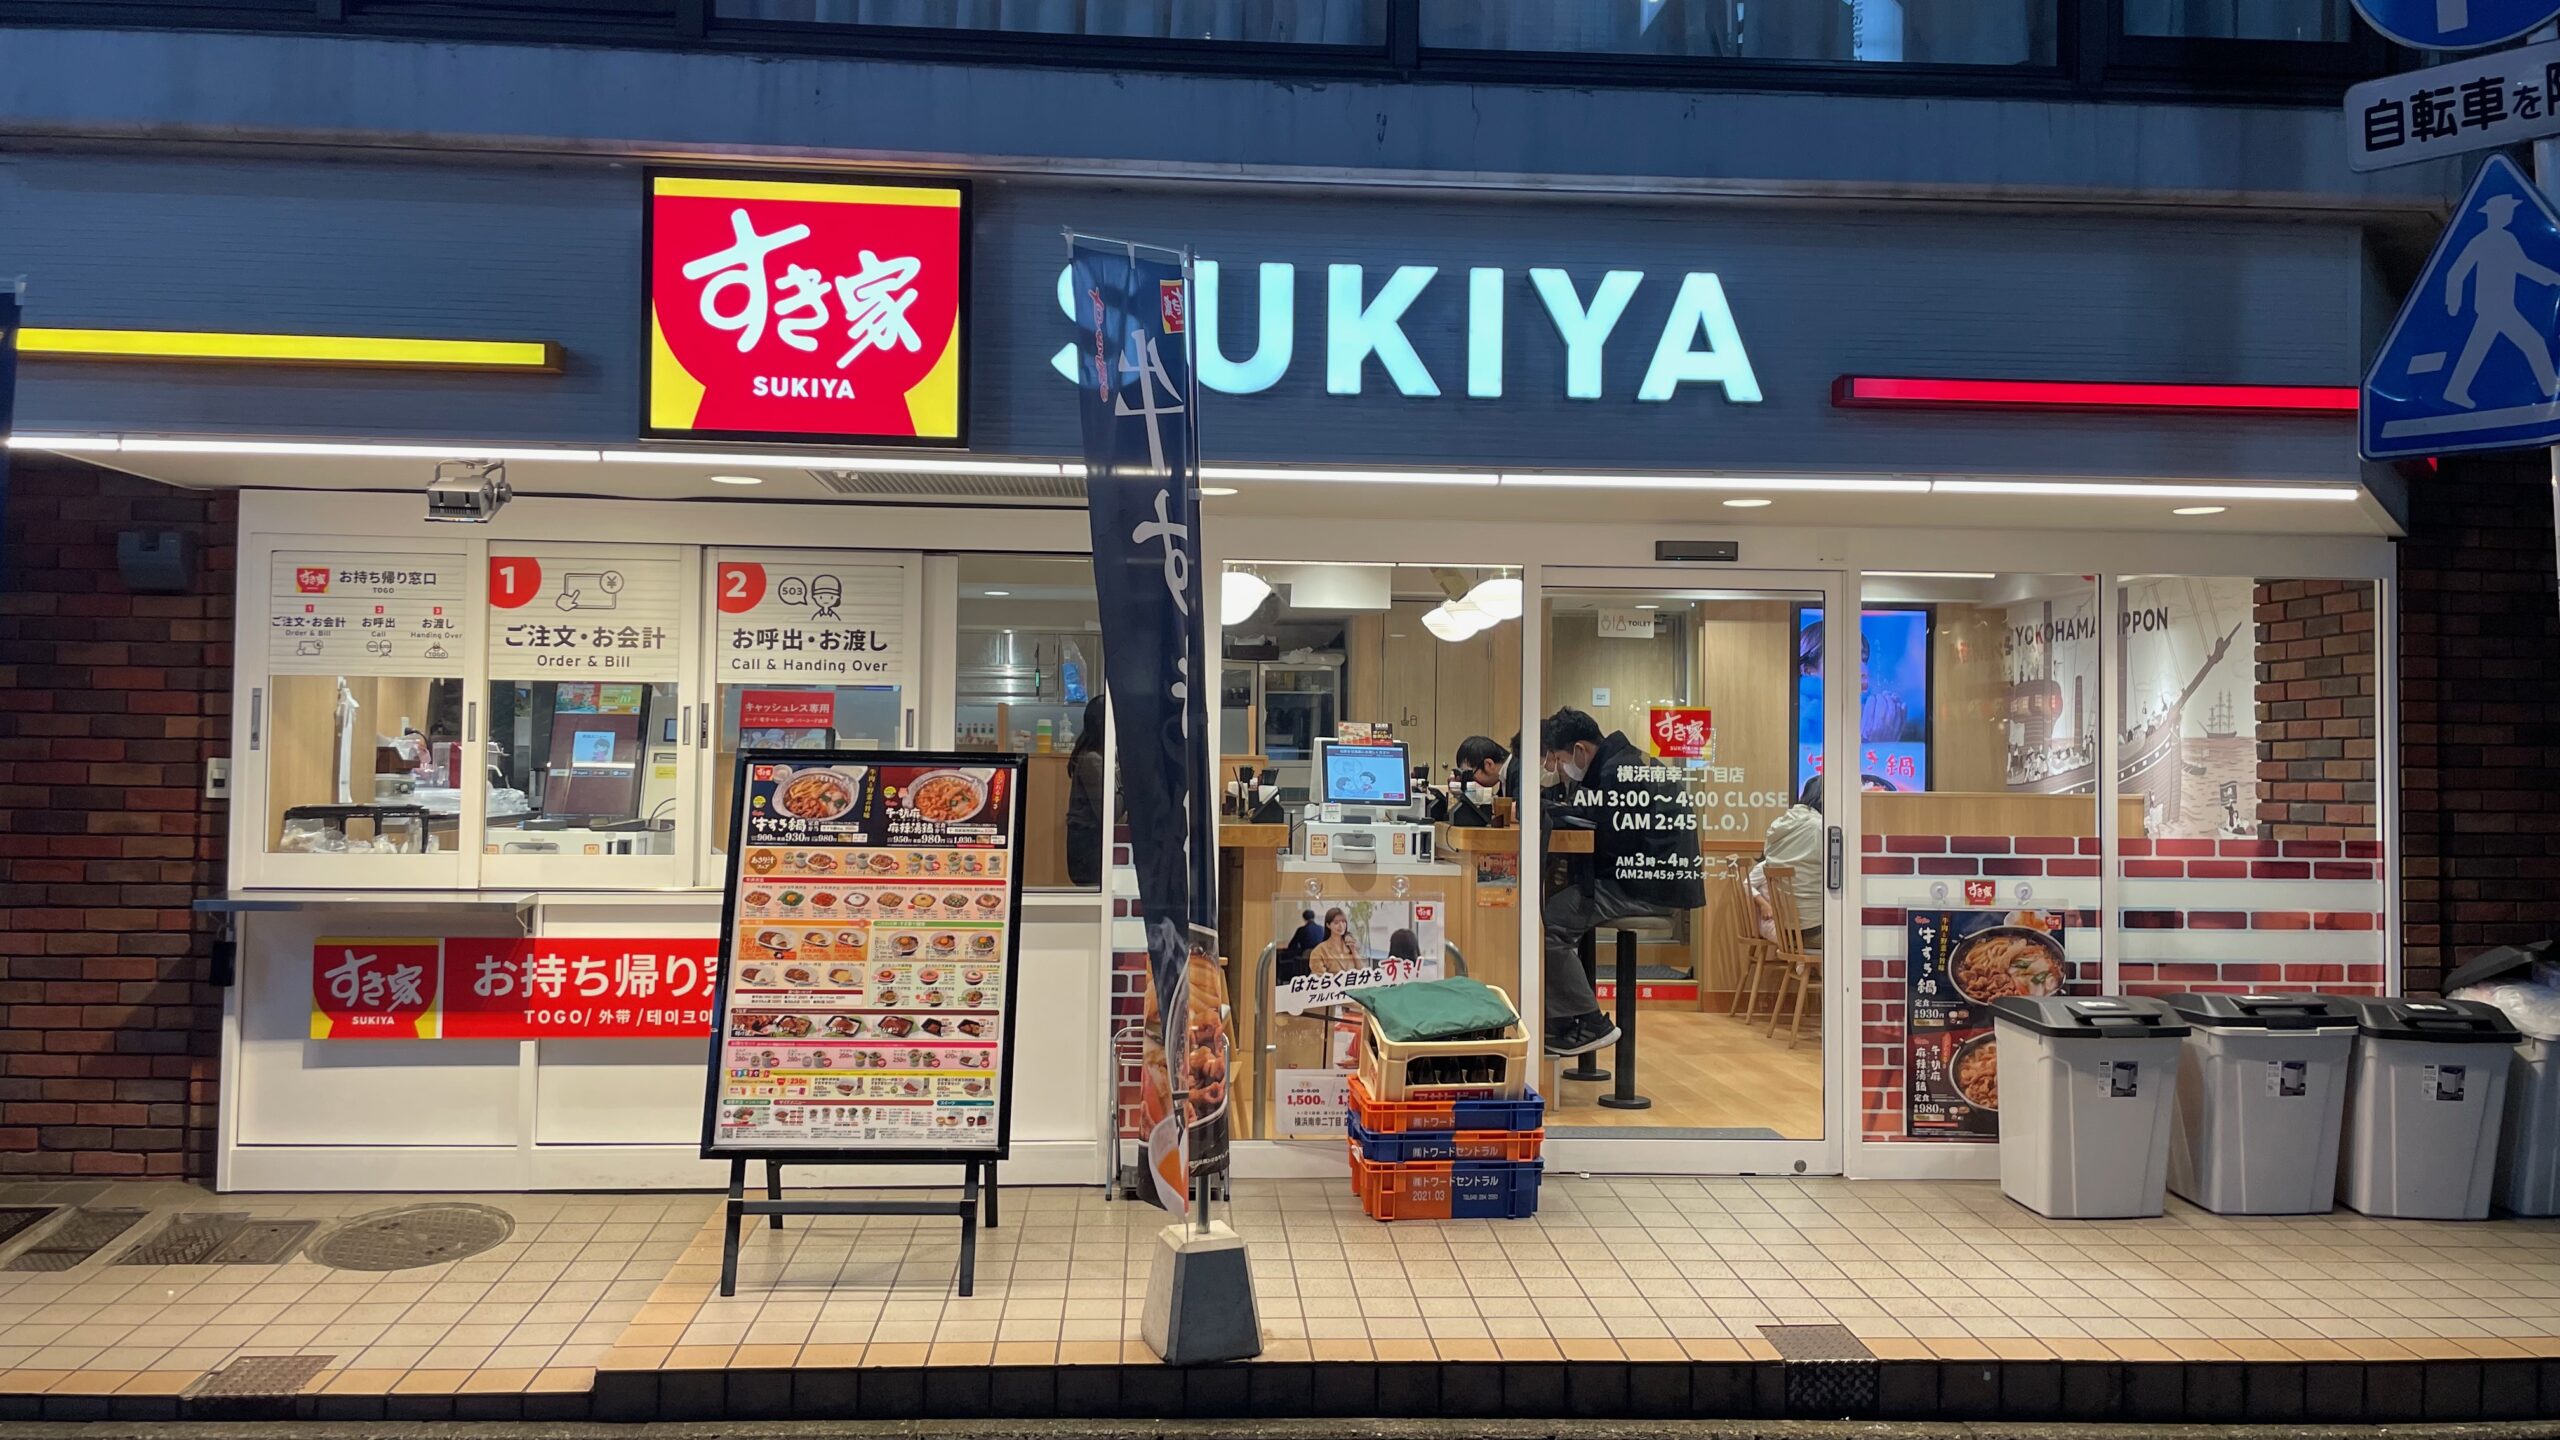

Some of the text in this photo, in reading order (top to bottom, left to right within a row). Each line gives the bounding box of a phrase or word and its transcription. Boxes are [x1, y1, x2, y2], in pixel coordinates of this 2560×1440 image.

[2364, 62, 2560, 153] 自転車を
[682, 208, 922, 369] すき家
[752, 376, 856, 400] SUKIYA
[299, 569, 328, 586] すき家
[339, 570, 437, 586] お持ち帰り窓口
[499, 566, 515, 594] 1
[725, 571, 747, 598] 2
[781, 586, 803, 597] 503
[271, 616, 347, 628] ご注文・お会計
[361, 617, 396, 628] お呼出
[421, 618, 455, 629] お渡し
[2117, 606, 2169, 636] IPPON
[505, 624, 667, 650] ご注文・お会計
[732, 628, 889, 652] お呼出・お渡し
[537, 655, 631, 668] Order & Bill
[732, 658, 889, 673] Call & Handing Over
[744, 702, 830, 714] キャッシュレス専用
[1656, 711, 1706, 745] すき家
[1616, 765, 1745, 783] 横浜南幸二丁目店
[1573, 790, 1603, 807] AM
[1607, 790, 1650, 807] 3:00
[1675, 791, 1719, 808] 4:00
[1724, 791, 1790, 808] CLOSE
[751, 816, 807, 832] 牛すき鍋
[1612, 812, 1750, 832] (AM 2:45 L.O.)
[1692, 854, 1739, 867] クローズ
[1967, 882, 1993, 899] すき家
[1917, 926, 1938, 995] 牛すき鍋
[324, 949, 424, 1012] すき家
[351, 1015, 395, 1026] SUKIYA
[523, 1008, 592, 1027] TOGO/
